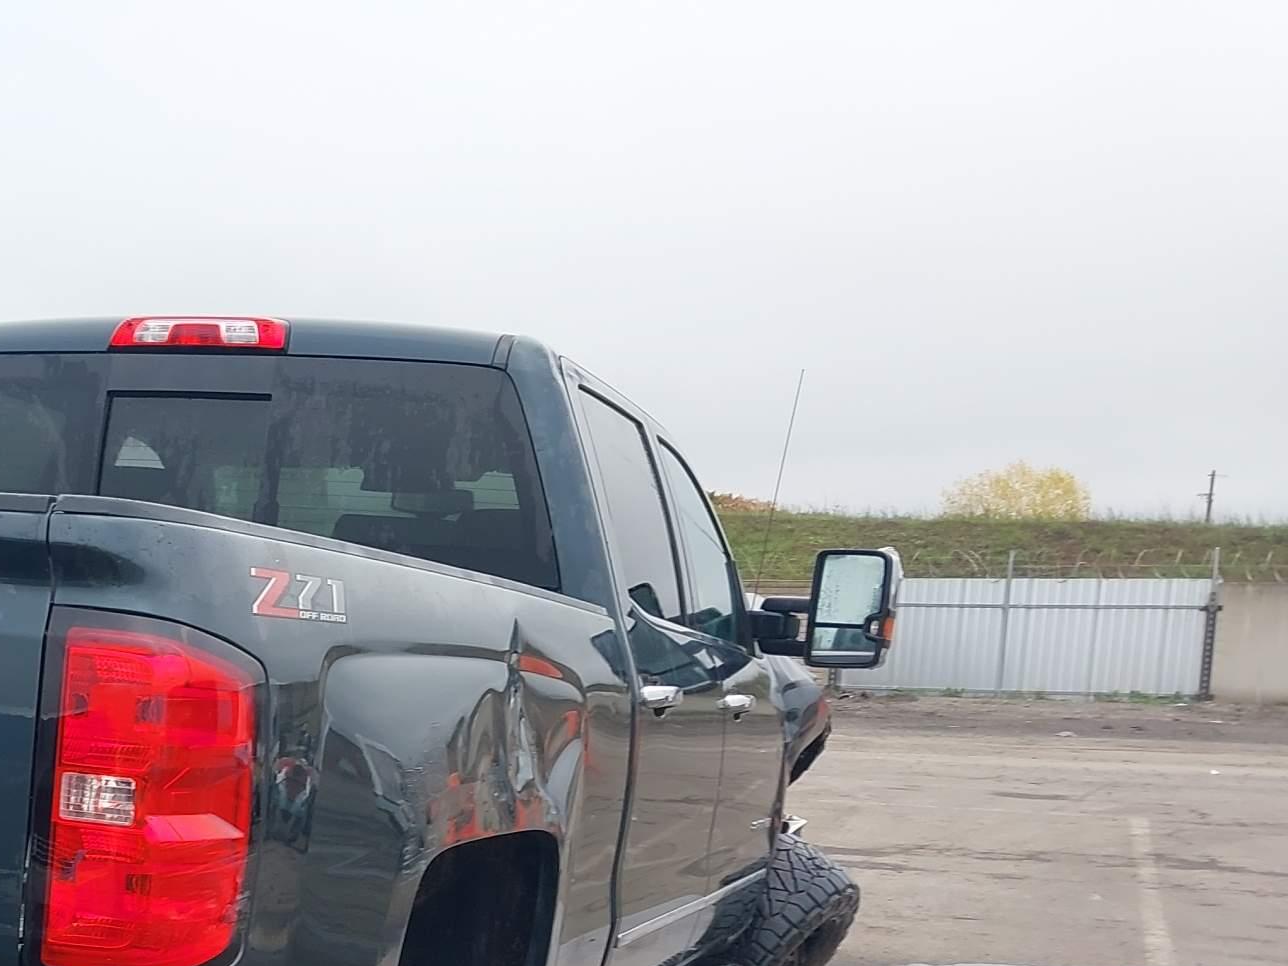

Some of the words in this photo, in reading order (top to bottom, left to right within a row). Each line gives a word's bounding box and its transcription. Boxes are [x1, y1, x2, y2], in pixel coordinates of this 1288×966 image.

[250, 567, 346, 619] Z71
[299, 611, 320, 620] OFF
[320, 613, 346, 622] ROAD
